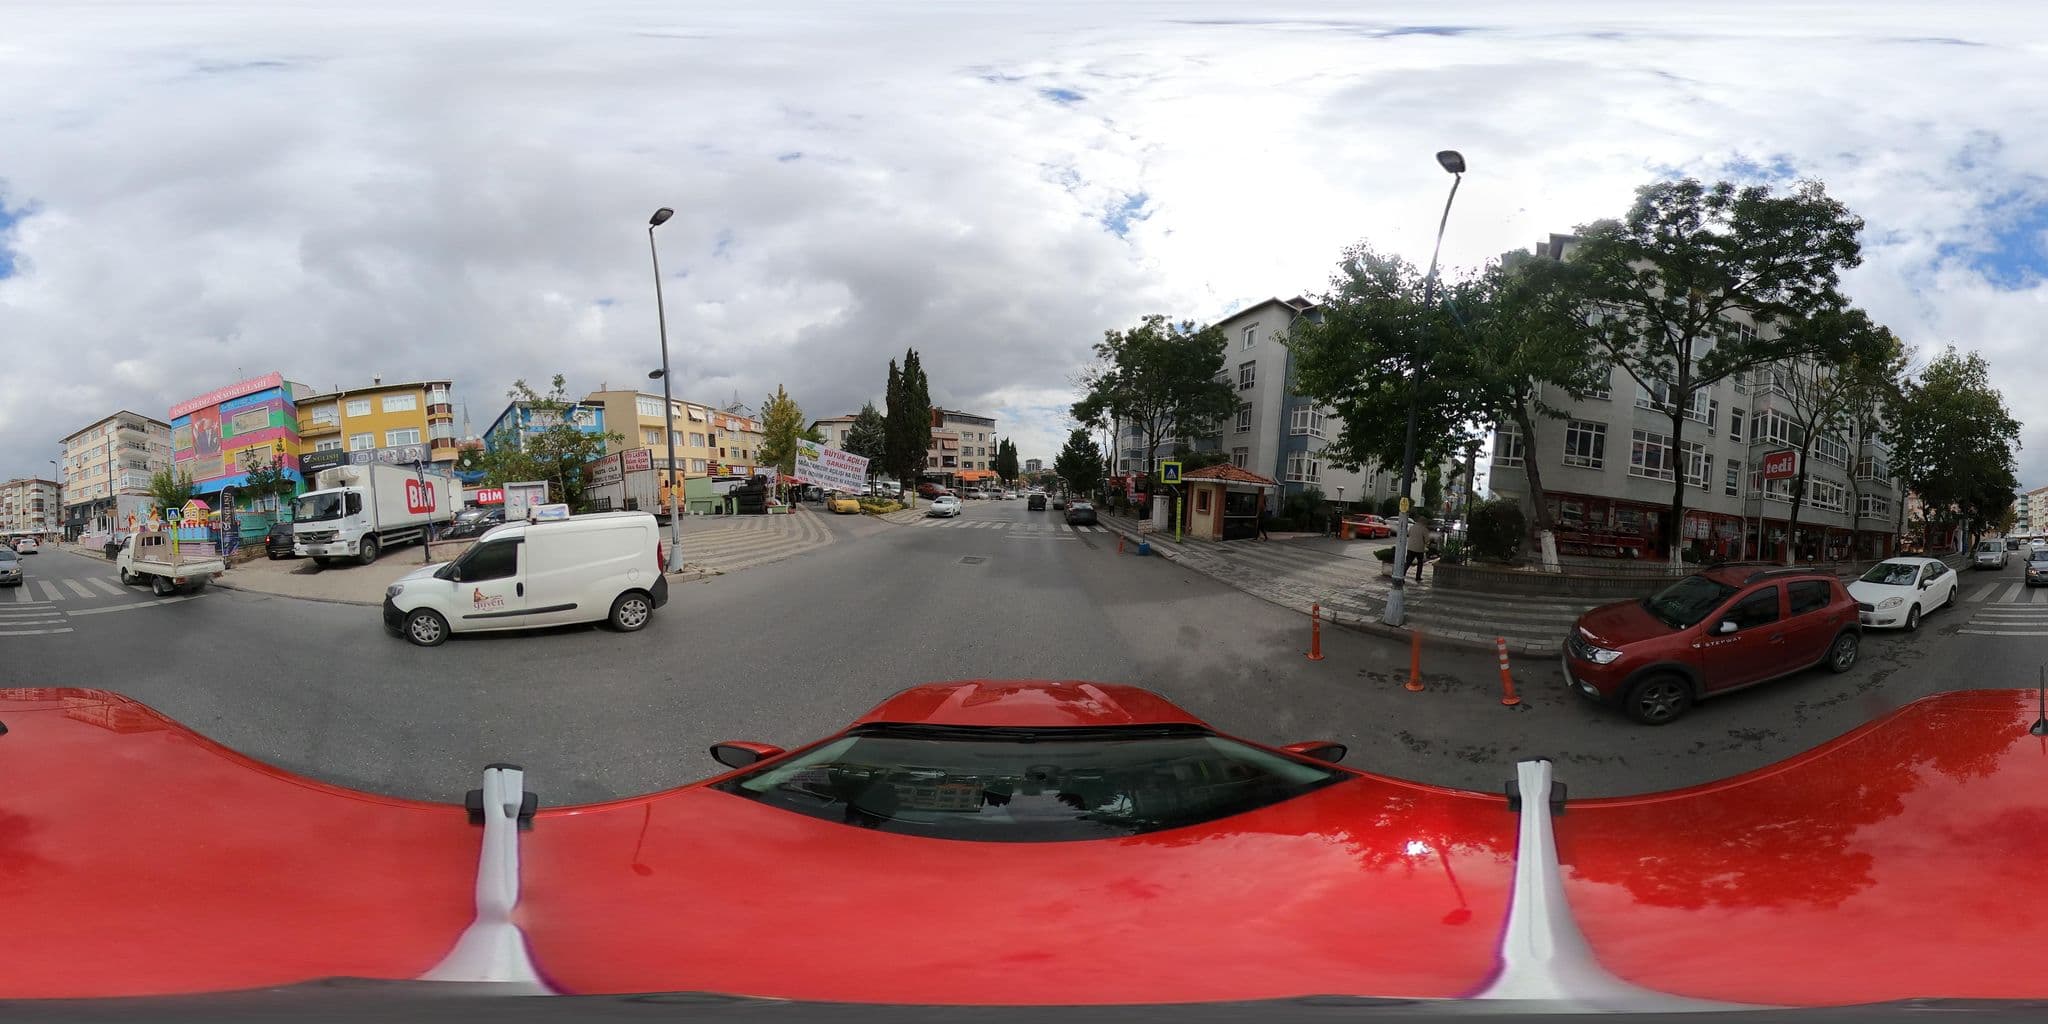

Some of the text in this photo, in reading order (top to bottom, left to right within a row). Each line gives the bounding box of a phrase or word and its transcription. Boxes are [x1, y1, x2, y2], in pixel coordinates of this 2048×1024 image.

[824, 449, 846, 461] BÜYÜK
[1767, 457, 1792, 474] tedi
[480, 489, 502, 502] BİM
